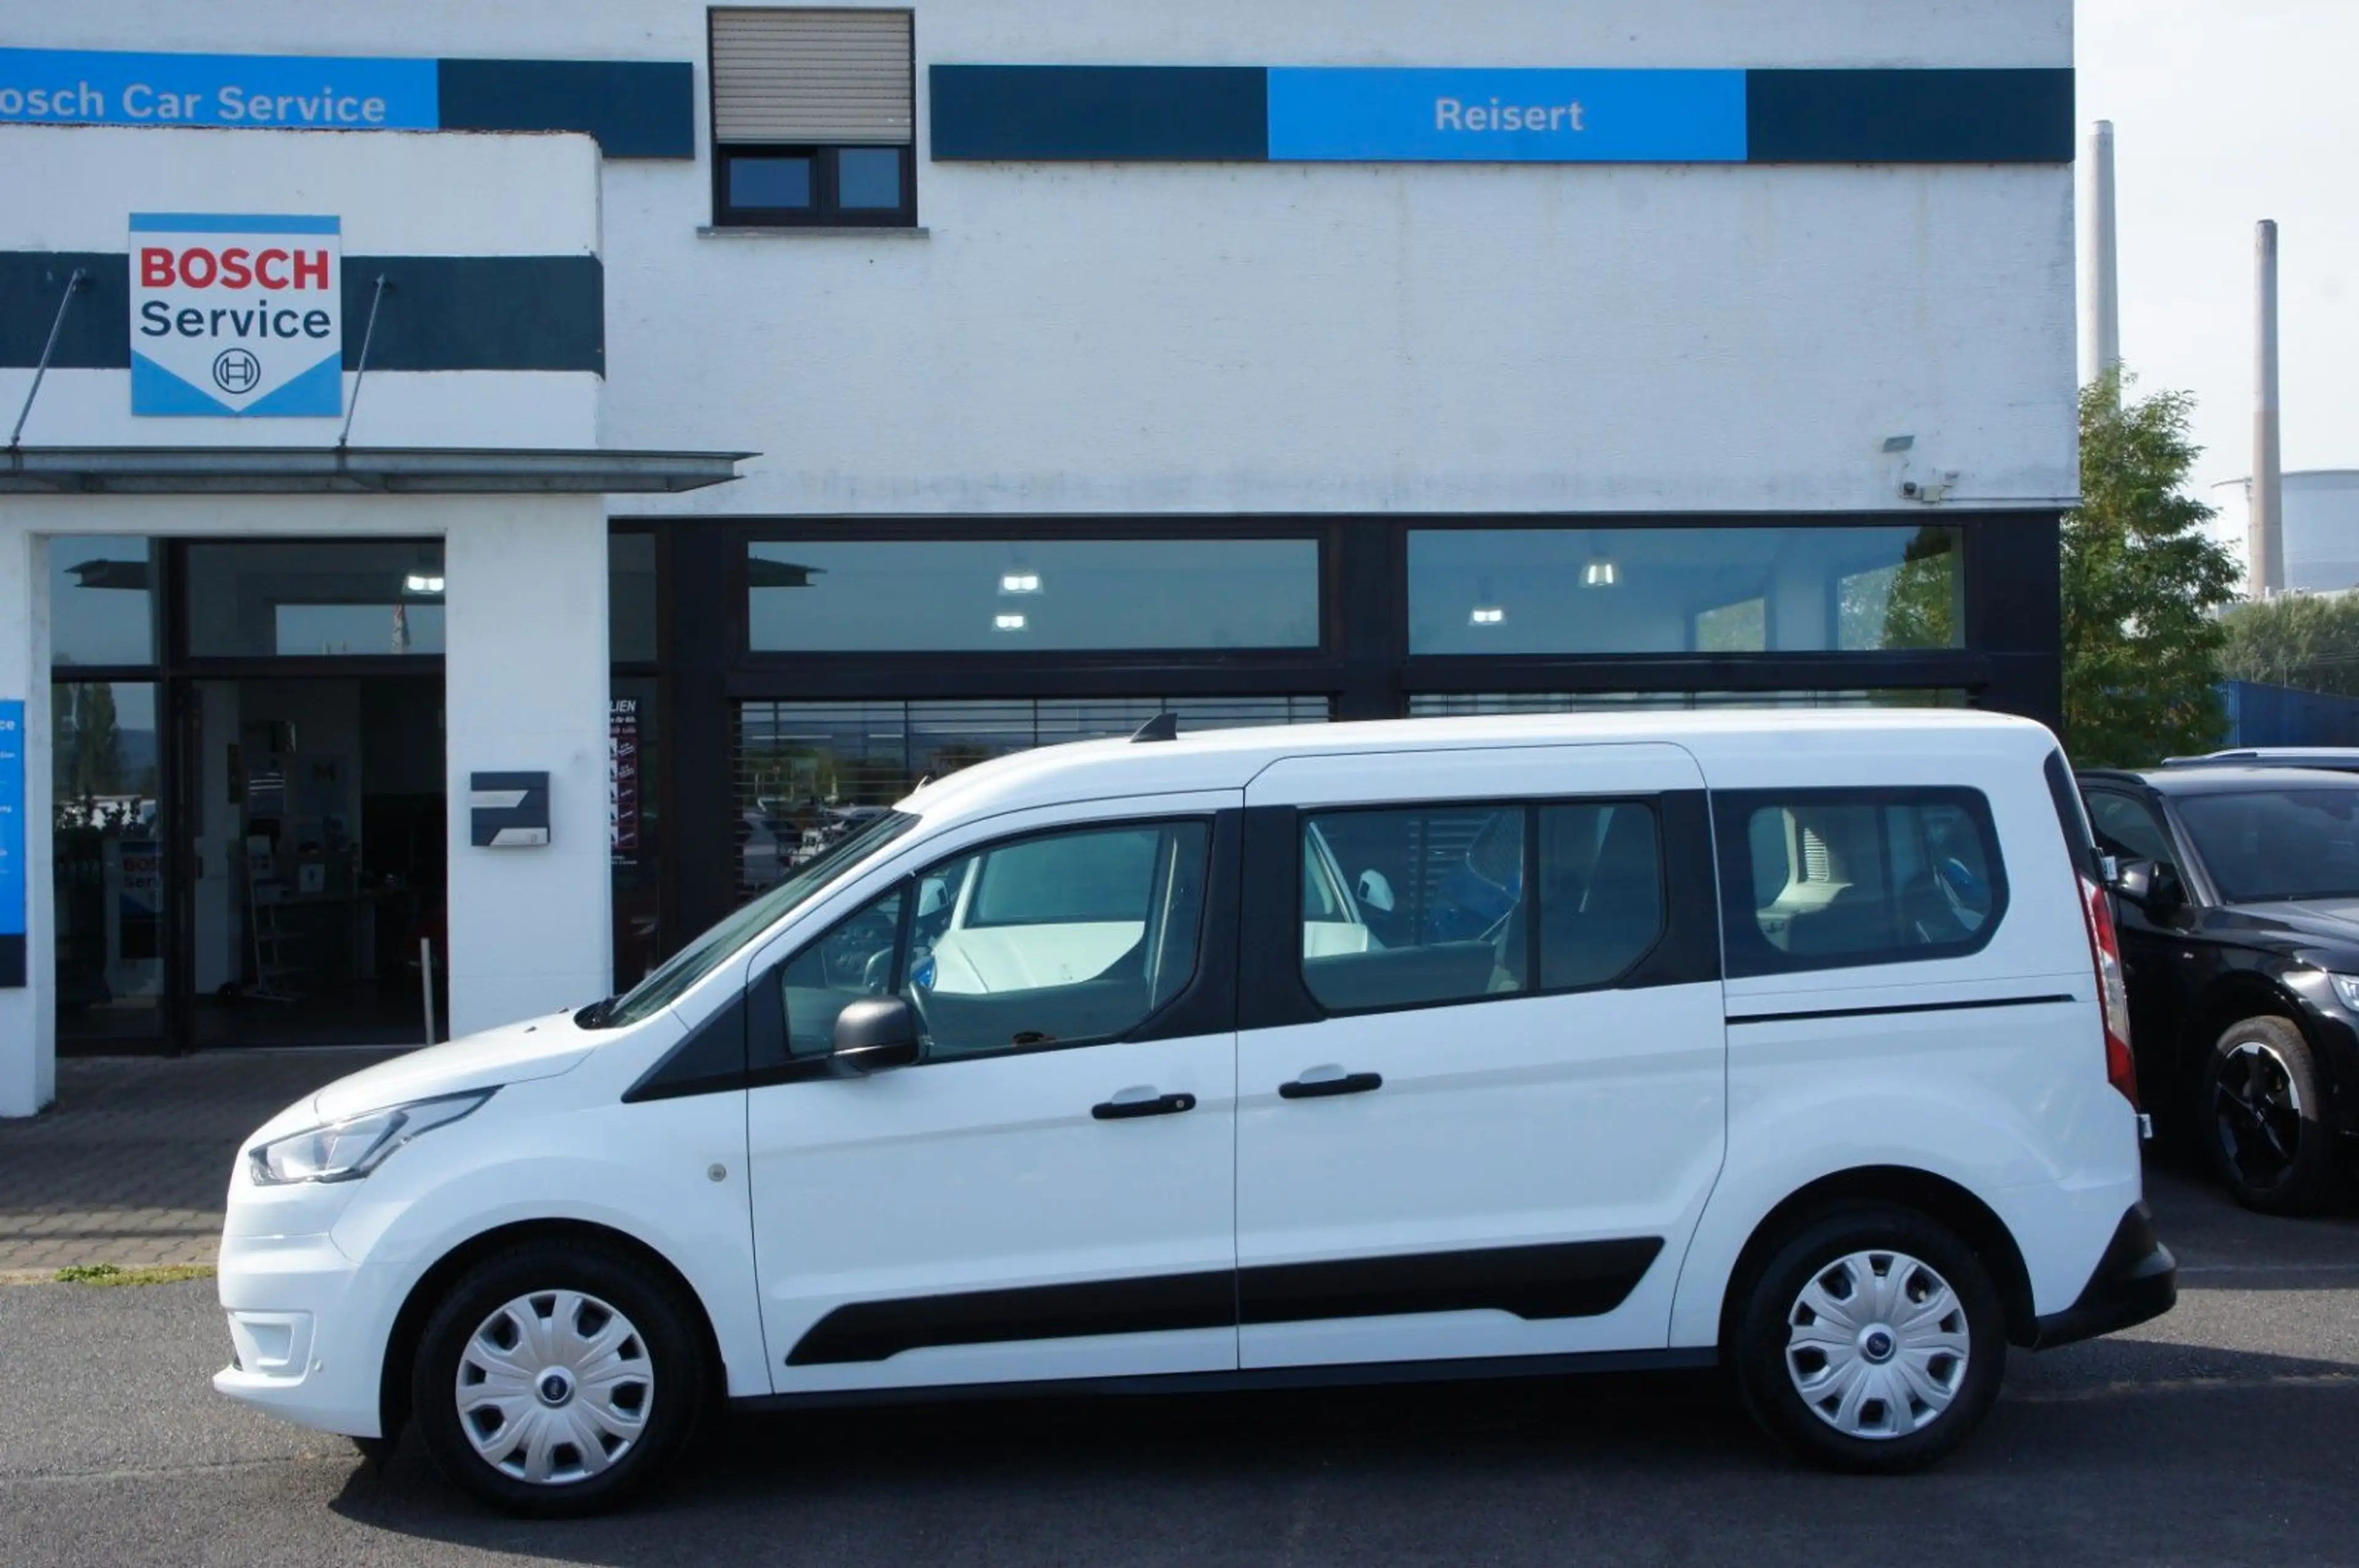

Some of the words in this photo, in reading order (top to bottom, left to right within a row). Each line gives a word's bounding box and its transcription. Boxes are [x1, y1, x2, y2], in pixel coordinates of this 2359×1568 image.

[123, 84, 201, 119] Car
[218, 86, 386, 122] Service
[1435, 97, 1584, 131] Reisert
[141, 248, 329, 290] BOSCH
[141, 300, 331, 338] Service
